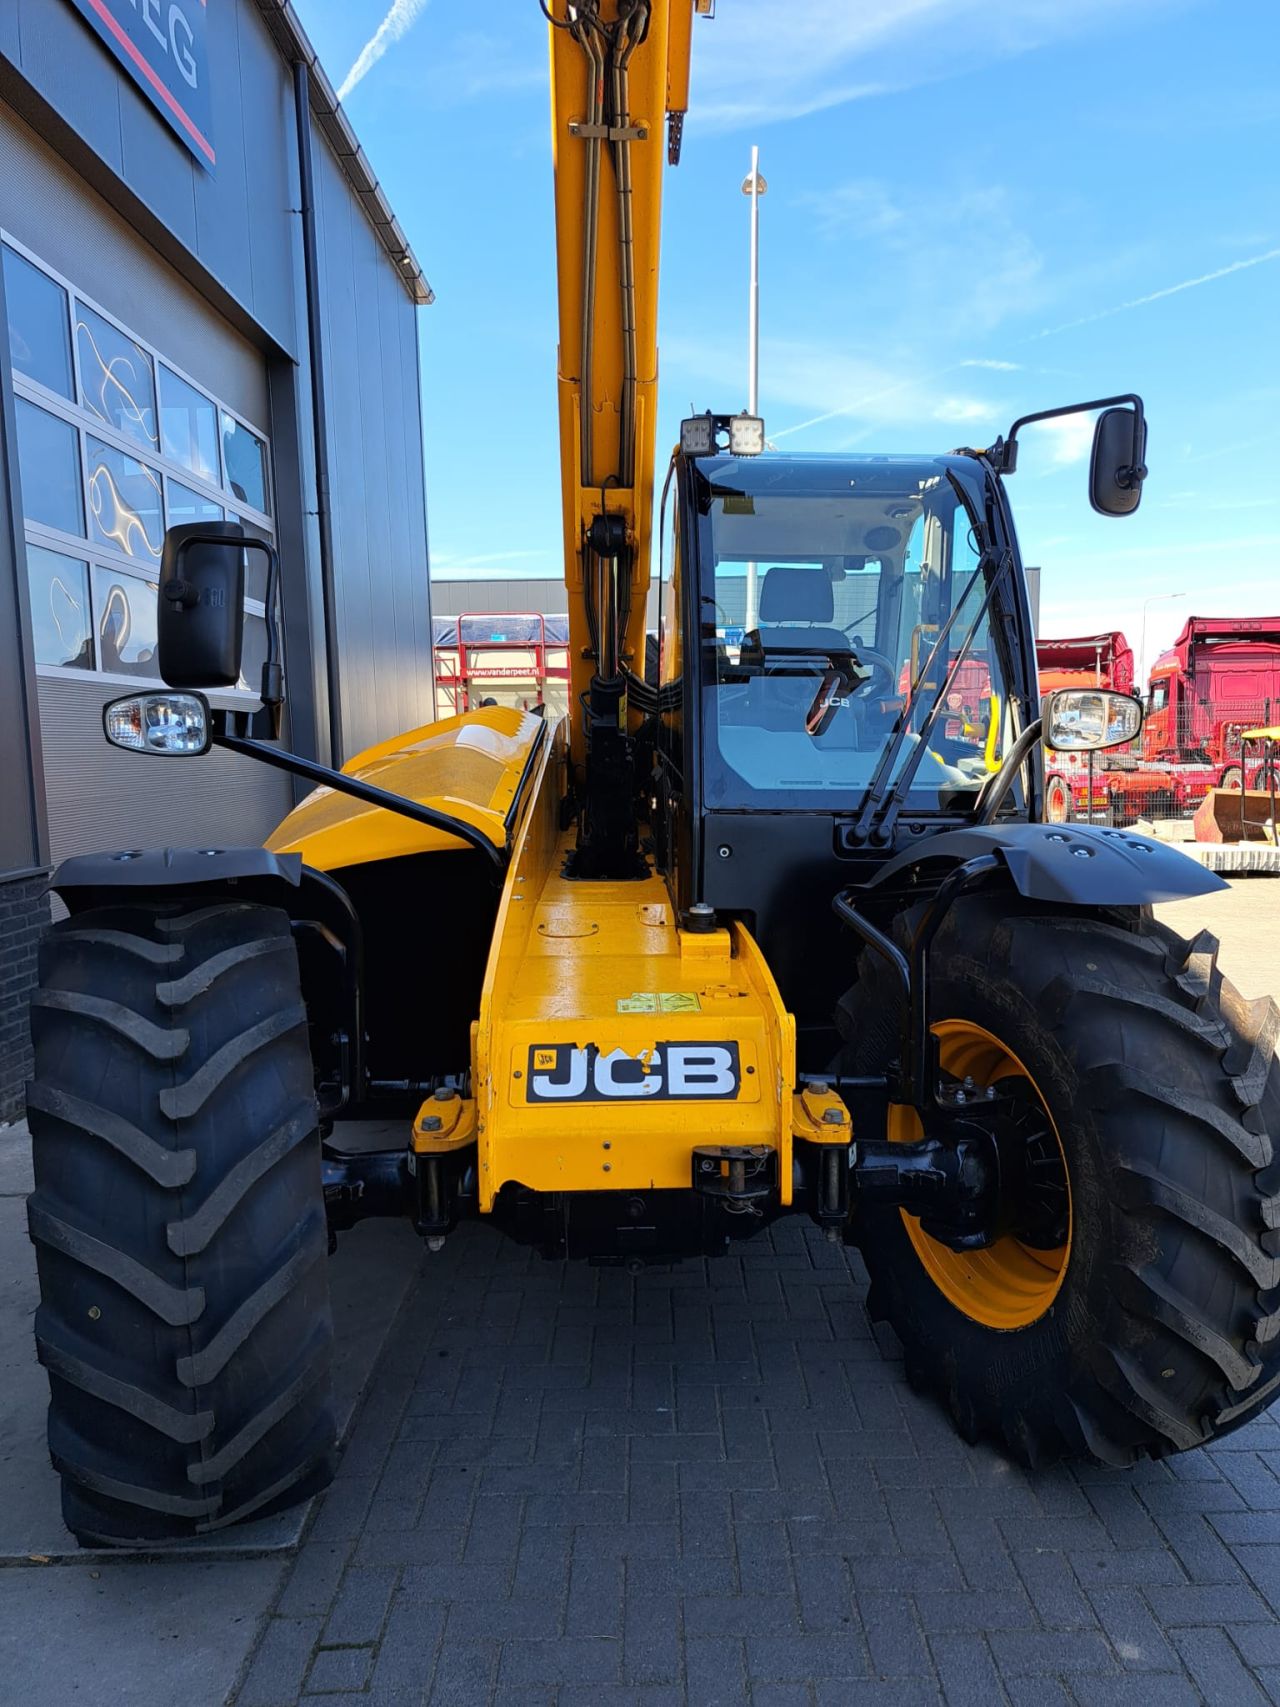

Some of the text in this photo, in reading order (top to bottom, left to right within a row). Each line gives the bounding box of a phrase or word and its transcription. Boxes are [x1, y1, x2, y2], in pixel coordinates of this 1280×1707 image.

[466, 668, 540, 677] www.vanderpeet.nl
[819, 697, 850, 708] JCB
[532, 1047, 736, 1098] JCB
